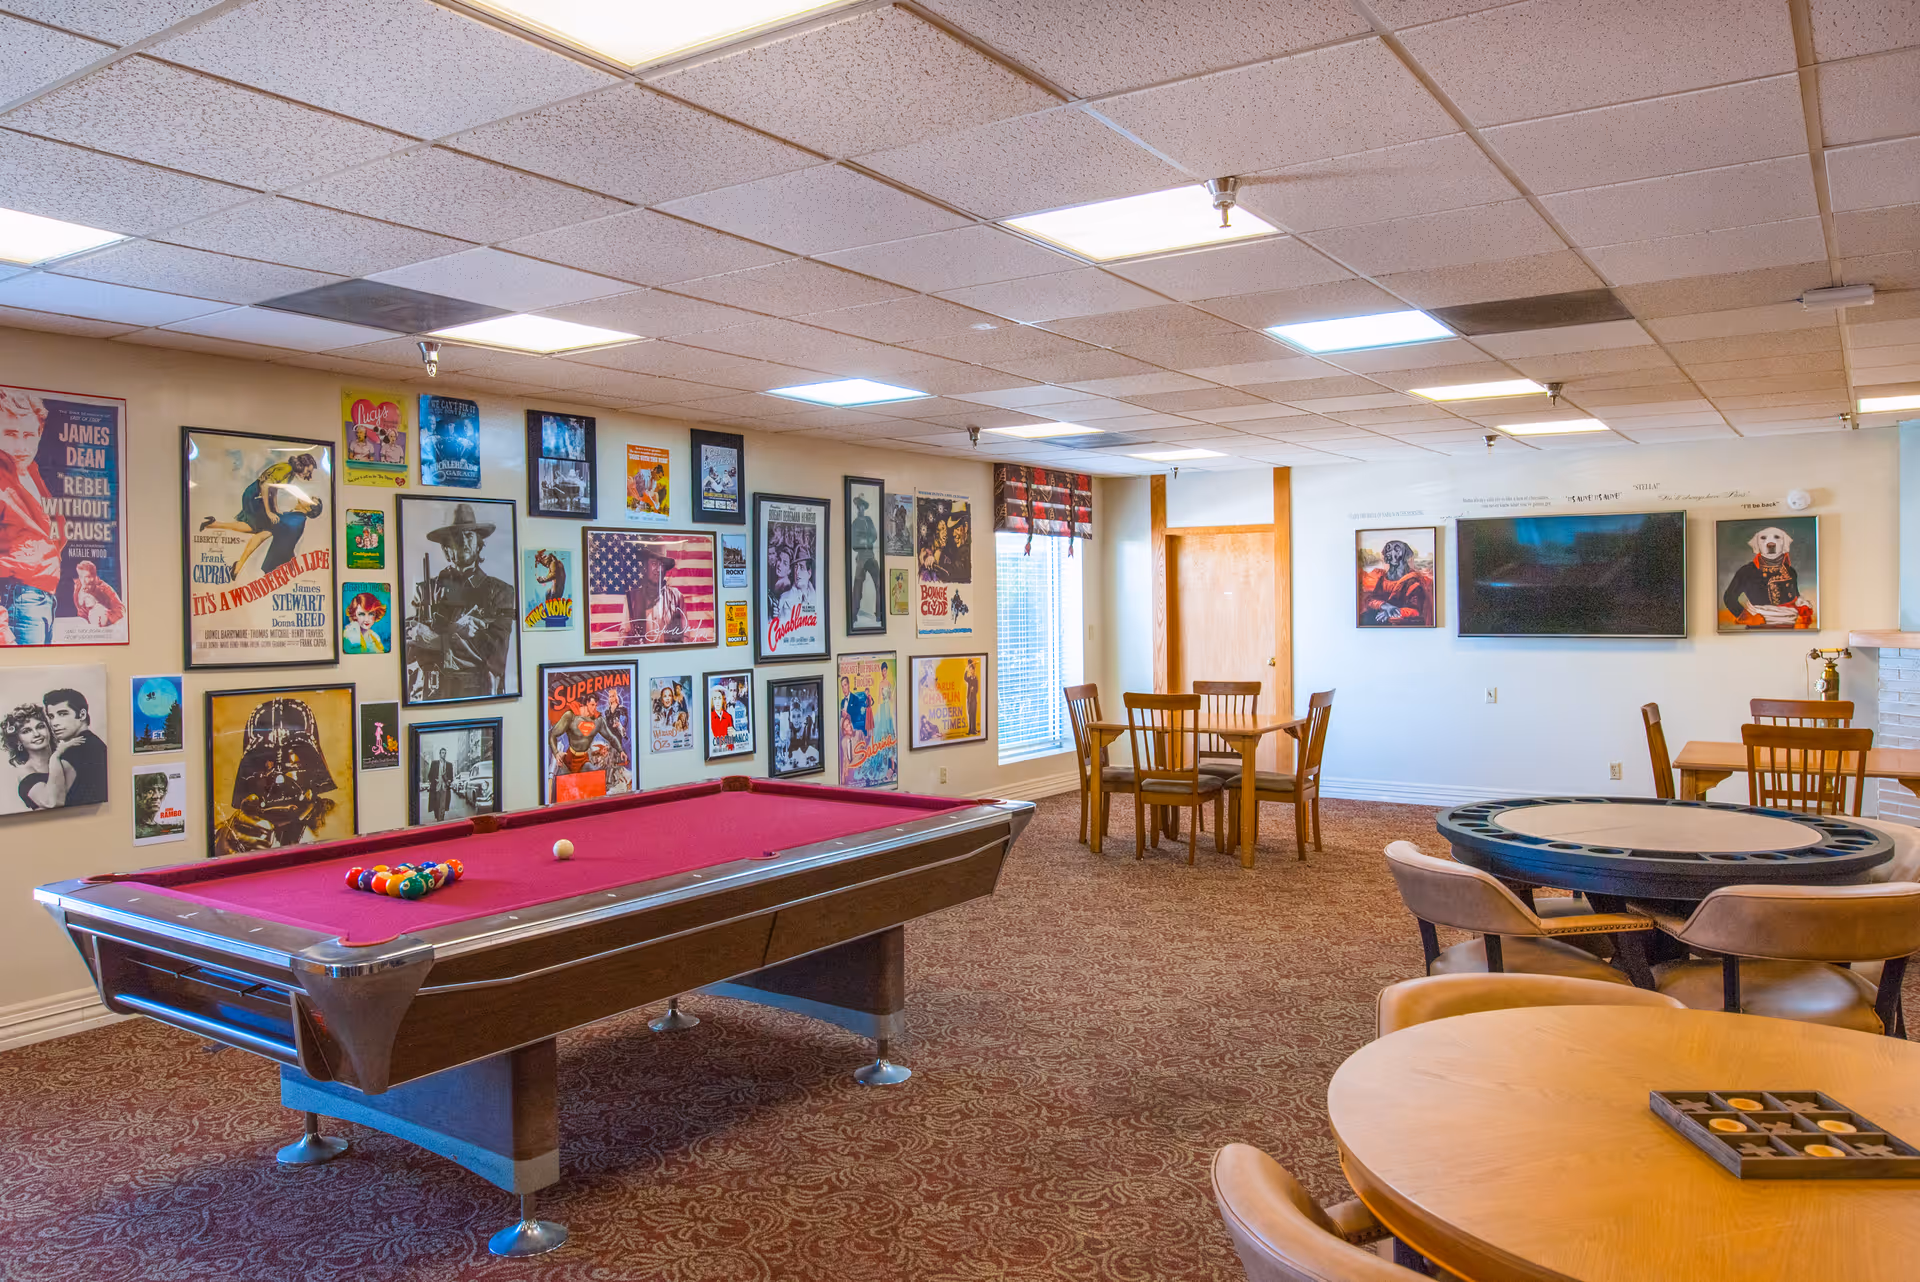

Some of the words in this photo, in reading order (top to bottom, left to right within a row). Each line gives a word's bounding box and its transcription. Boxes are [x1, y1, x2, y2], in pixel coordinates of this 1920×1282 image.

[58, 422, 110, 446] JAMES
[66, 446, 105, 469] DEAN
[41, 497, 110, 519] WITHOUT
[49, 521, 60, 540] A
[194, 535, 219, 544] LIBERTY
[221, 535, 240, 544] FILMS
[68, 548, 89, 558] NATALIE
[91, 548, 107, 559] WOOD
[200, 552, 225, 563] Frank
[220, 591, 231, 611] A
[228, 556, 304, 608] WONDERFUL
[301, 549, 330, 572] LIFE
[292, 583, 321, 593] James
[272, 593, 325, 612] STEWART
[920, 599, 948, 616] CLYDE
[271, 618, 296, 628] Donna
[295, 612, 326, 628] REED
[525, 603, 547, 628] KING
[545, 598, 572, 617] KONG
[250, 629, 268, 639] THOMAS
[554, 674, 630, 711] SUPERMAN
[923, 690, 961, 705] CHAPLIN
[928, 705, 963, 720] MODERN
[942, 717, 966, 730] TIMES
[653, 740, 671, 751] OZ
[848, 734, 897, 768] Sabrina
[160, 810, 182, 819] RAMBO
